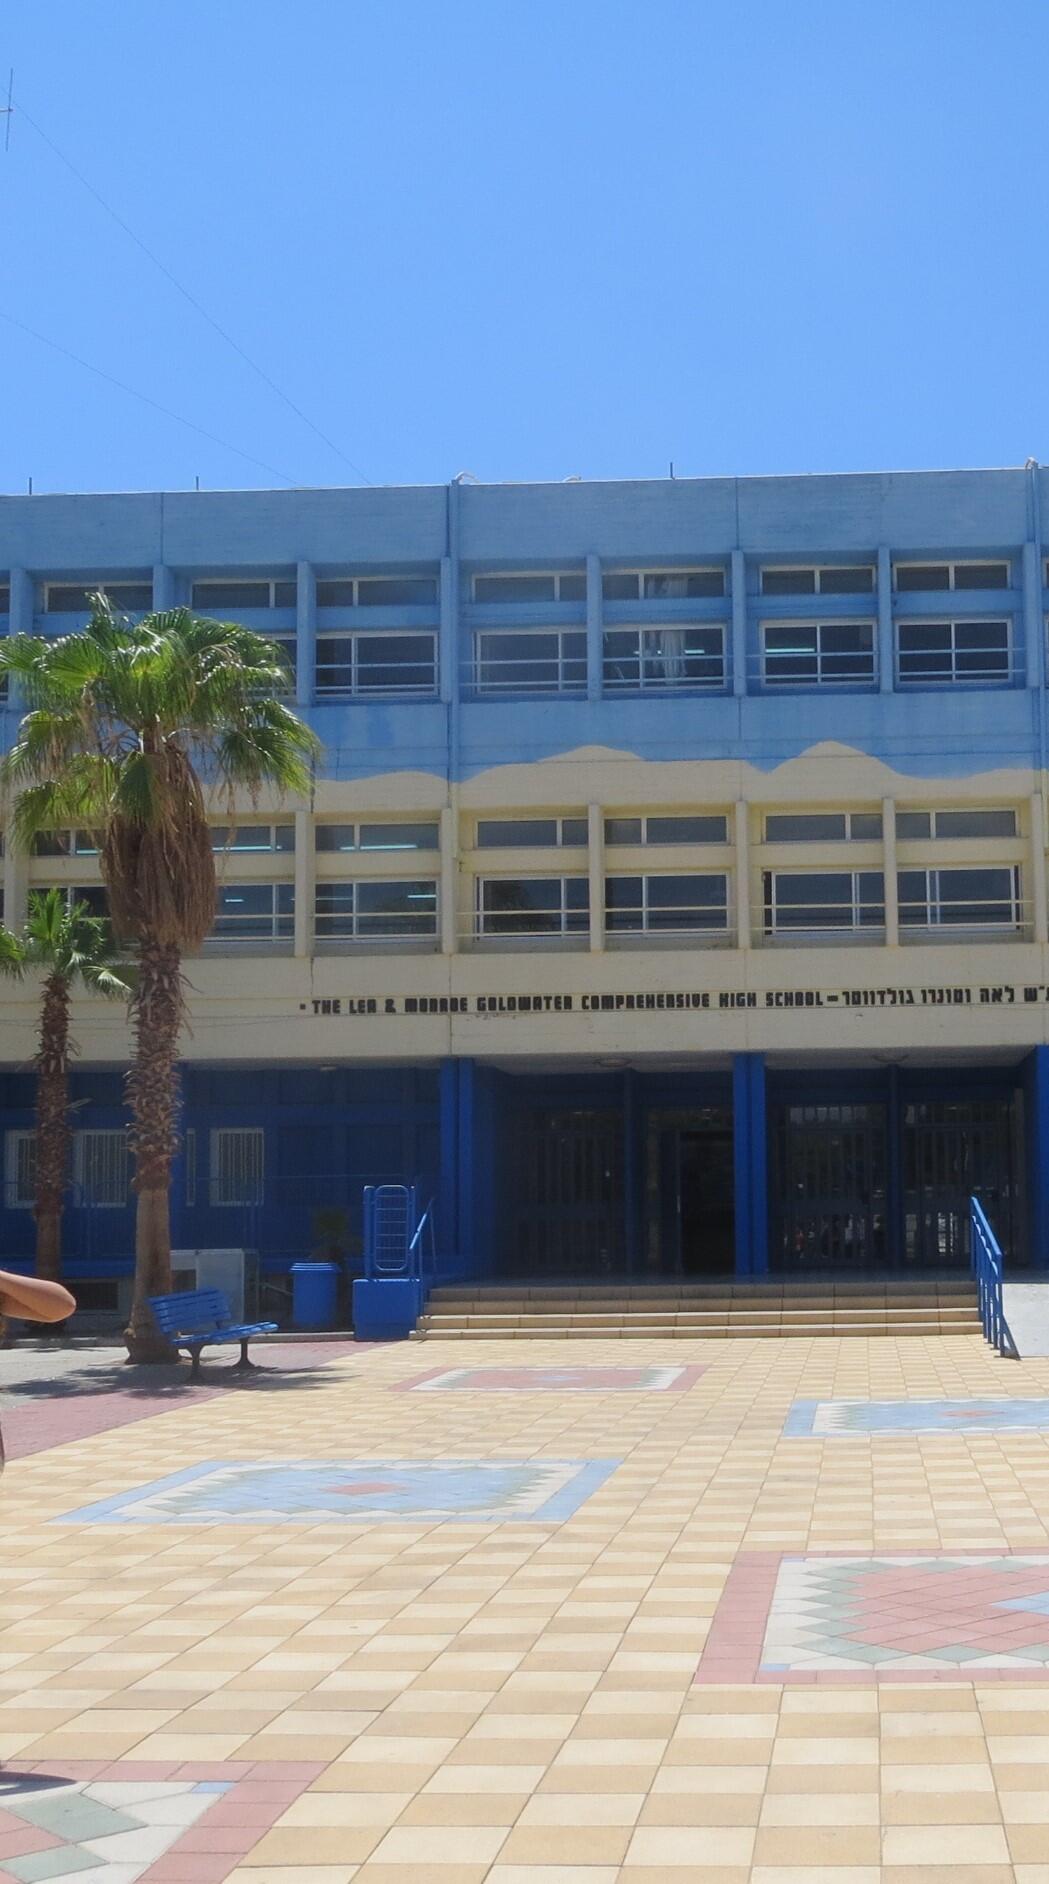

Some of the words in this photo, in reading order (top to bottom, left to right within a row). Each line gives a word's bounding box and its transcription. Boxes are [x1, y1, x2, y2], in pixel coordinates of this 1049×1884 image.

[920, 988, 971, 1004] ומונרו
[979, 985, 1015, 1002] לאה
[312, 999, 341, 1014] THE
[350, 998, 377, 1014] LEA
[385, 998, 396, 1013] &
[404, 997, 468, 1013] MONROE
[477, 995, 573, 1011] GOLDWATER
[581, 993, 710, 1010] COMPREHENSIVE
[719, 992, 757, 1008] HIGH
